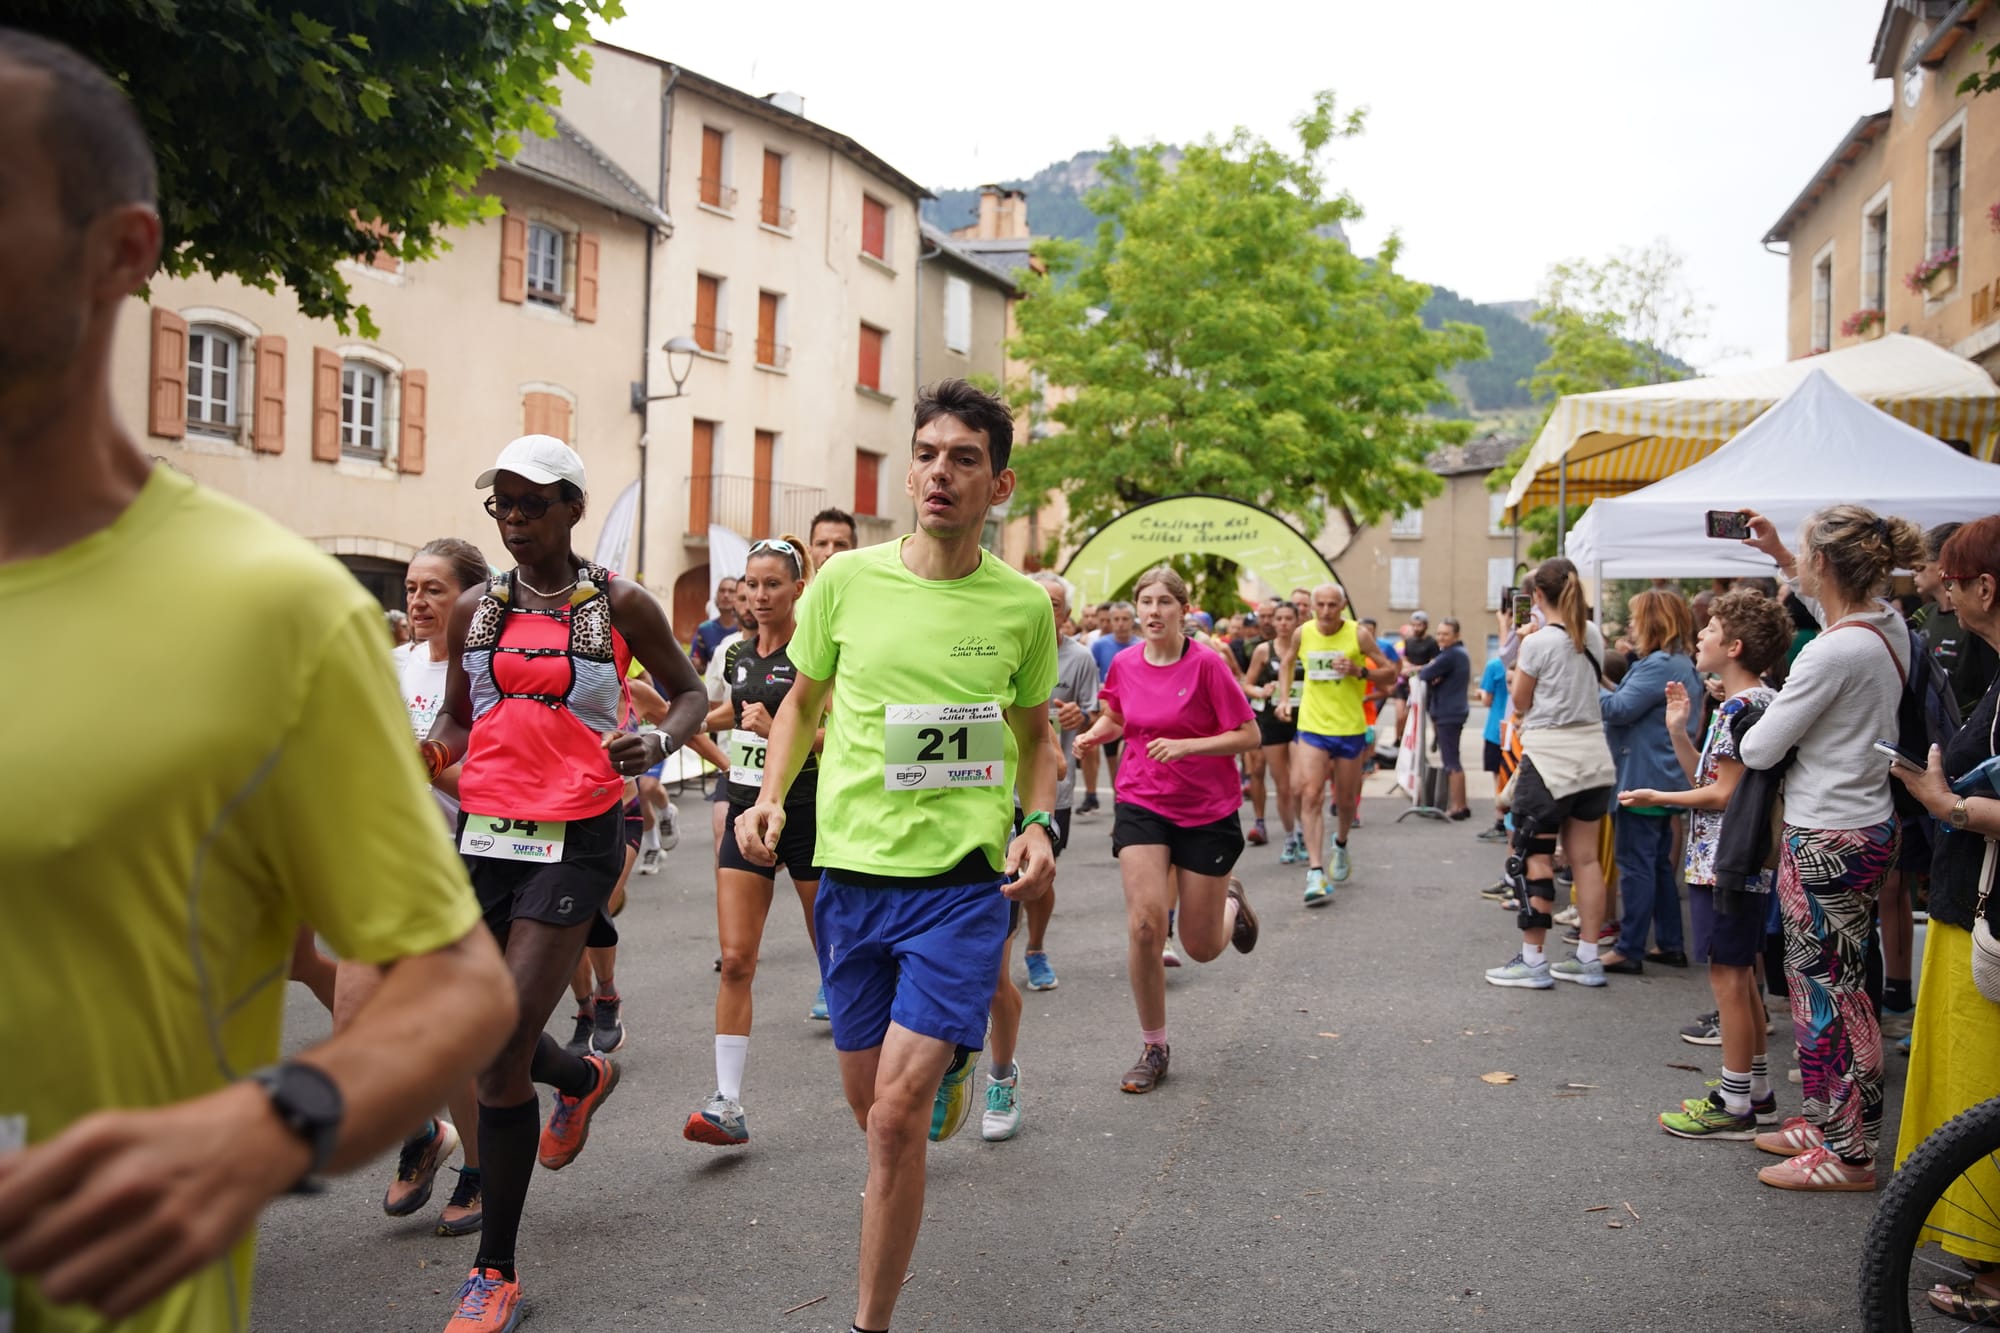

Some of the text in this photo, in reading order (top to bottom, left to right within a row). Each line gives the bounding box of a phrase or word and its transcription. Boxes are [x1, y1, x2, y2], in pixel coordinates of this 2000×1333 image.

[1140, 516, 1249, 532] Challenge des
[943, 707, 979, 716] Challenge
[916, 727, 968, 761] 21
[742, 745, 767, 769] 78
[896, 772, 922, 780] BFP
[948, 769, 982, 777] TUFF'S
[470, 839, 491, 847] BFP
[512, 843, 543, 853] TUFF'S
